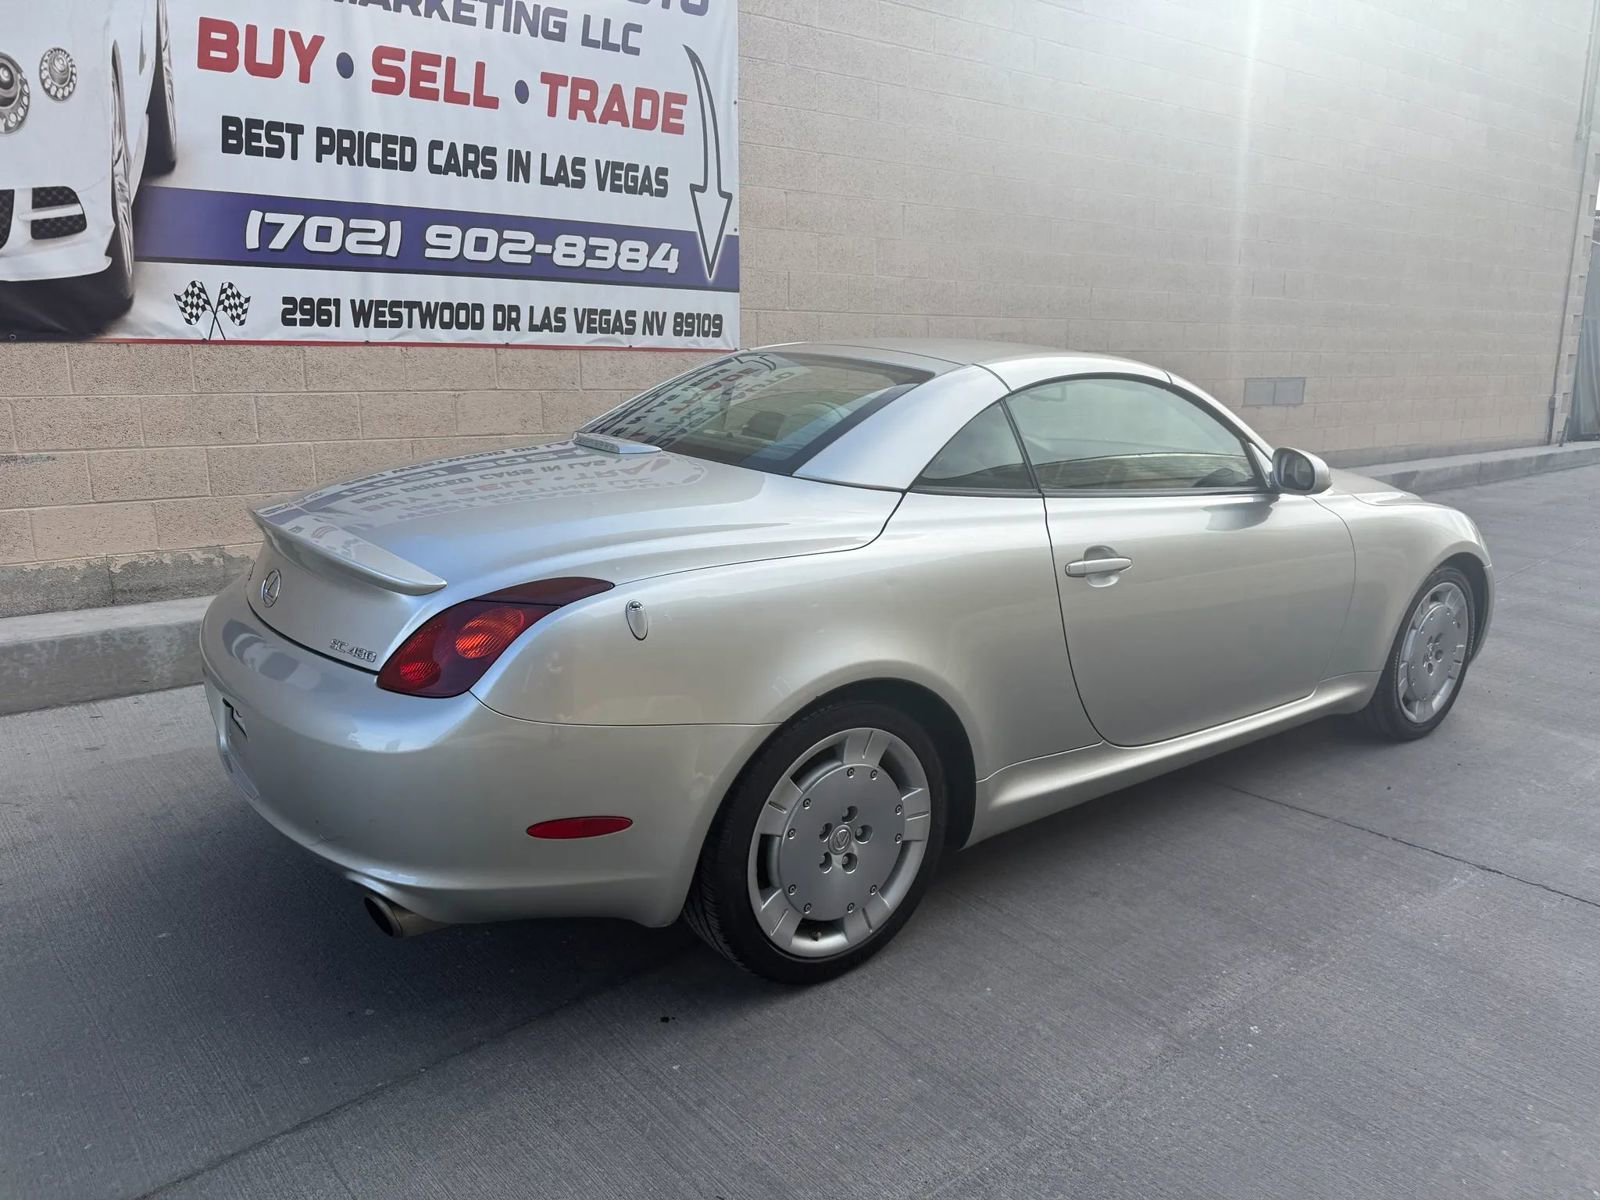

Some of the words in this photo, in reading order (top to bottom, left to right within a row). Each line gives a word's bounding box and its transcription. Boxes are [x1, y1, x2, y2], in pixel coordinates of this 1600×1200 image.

[581, 14, 643, 56] LLC
[197, 16, 325, 84] BUY
[371, 45, 499, 110] SELL
[540, 71, 687, 135] TRADE
[222, 115, 304, 161] BEST
[316, 126, 417, 172] PRICED
[428, 139, 498, 180] CARS
[507, 149, 531, 184] IN
[540, 153, 586, 189] LAS
[595, 159, 669, 198] VEGAS
[246, 209, 401, 258] (702)
[424, 224, 679, 274] 902-8384
[281, 296, 341, 328] 2961
[350, 298, 484, 331] WESTWOOD
[493, 303, 521, 332] DR
[528, 305, 566, 333] LAS
[574, 307, 637, 336] VEGAS
[642, 310, 667, 336] NV
[673, 312, 723, 338] 89109
